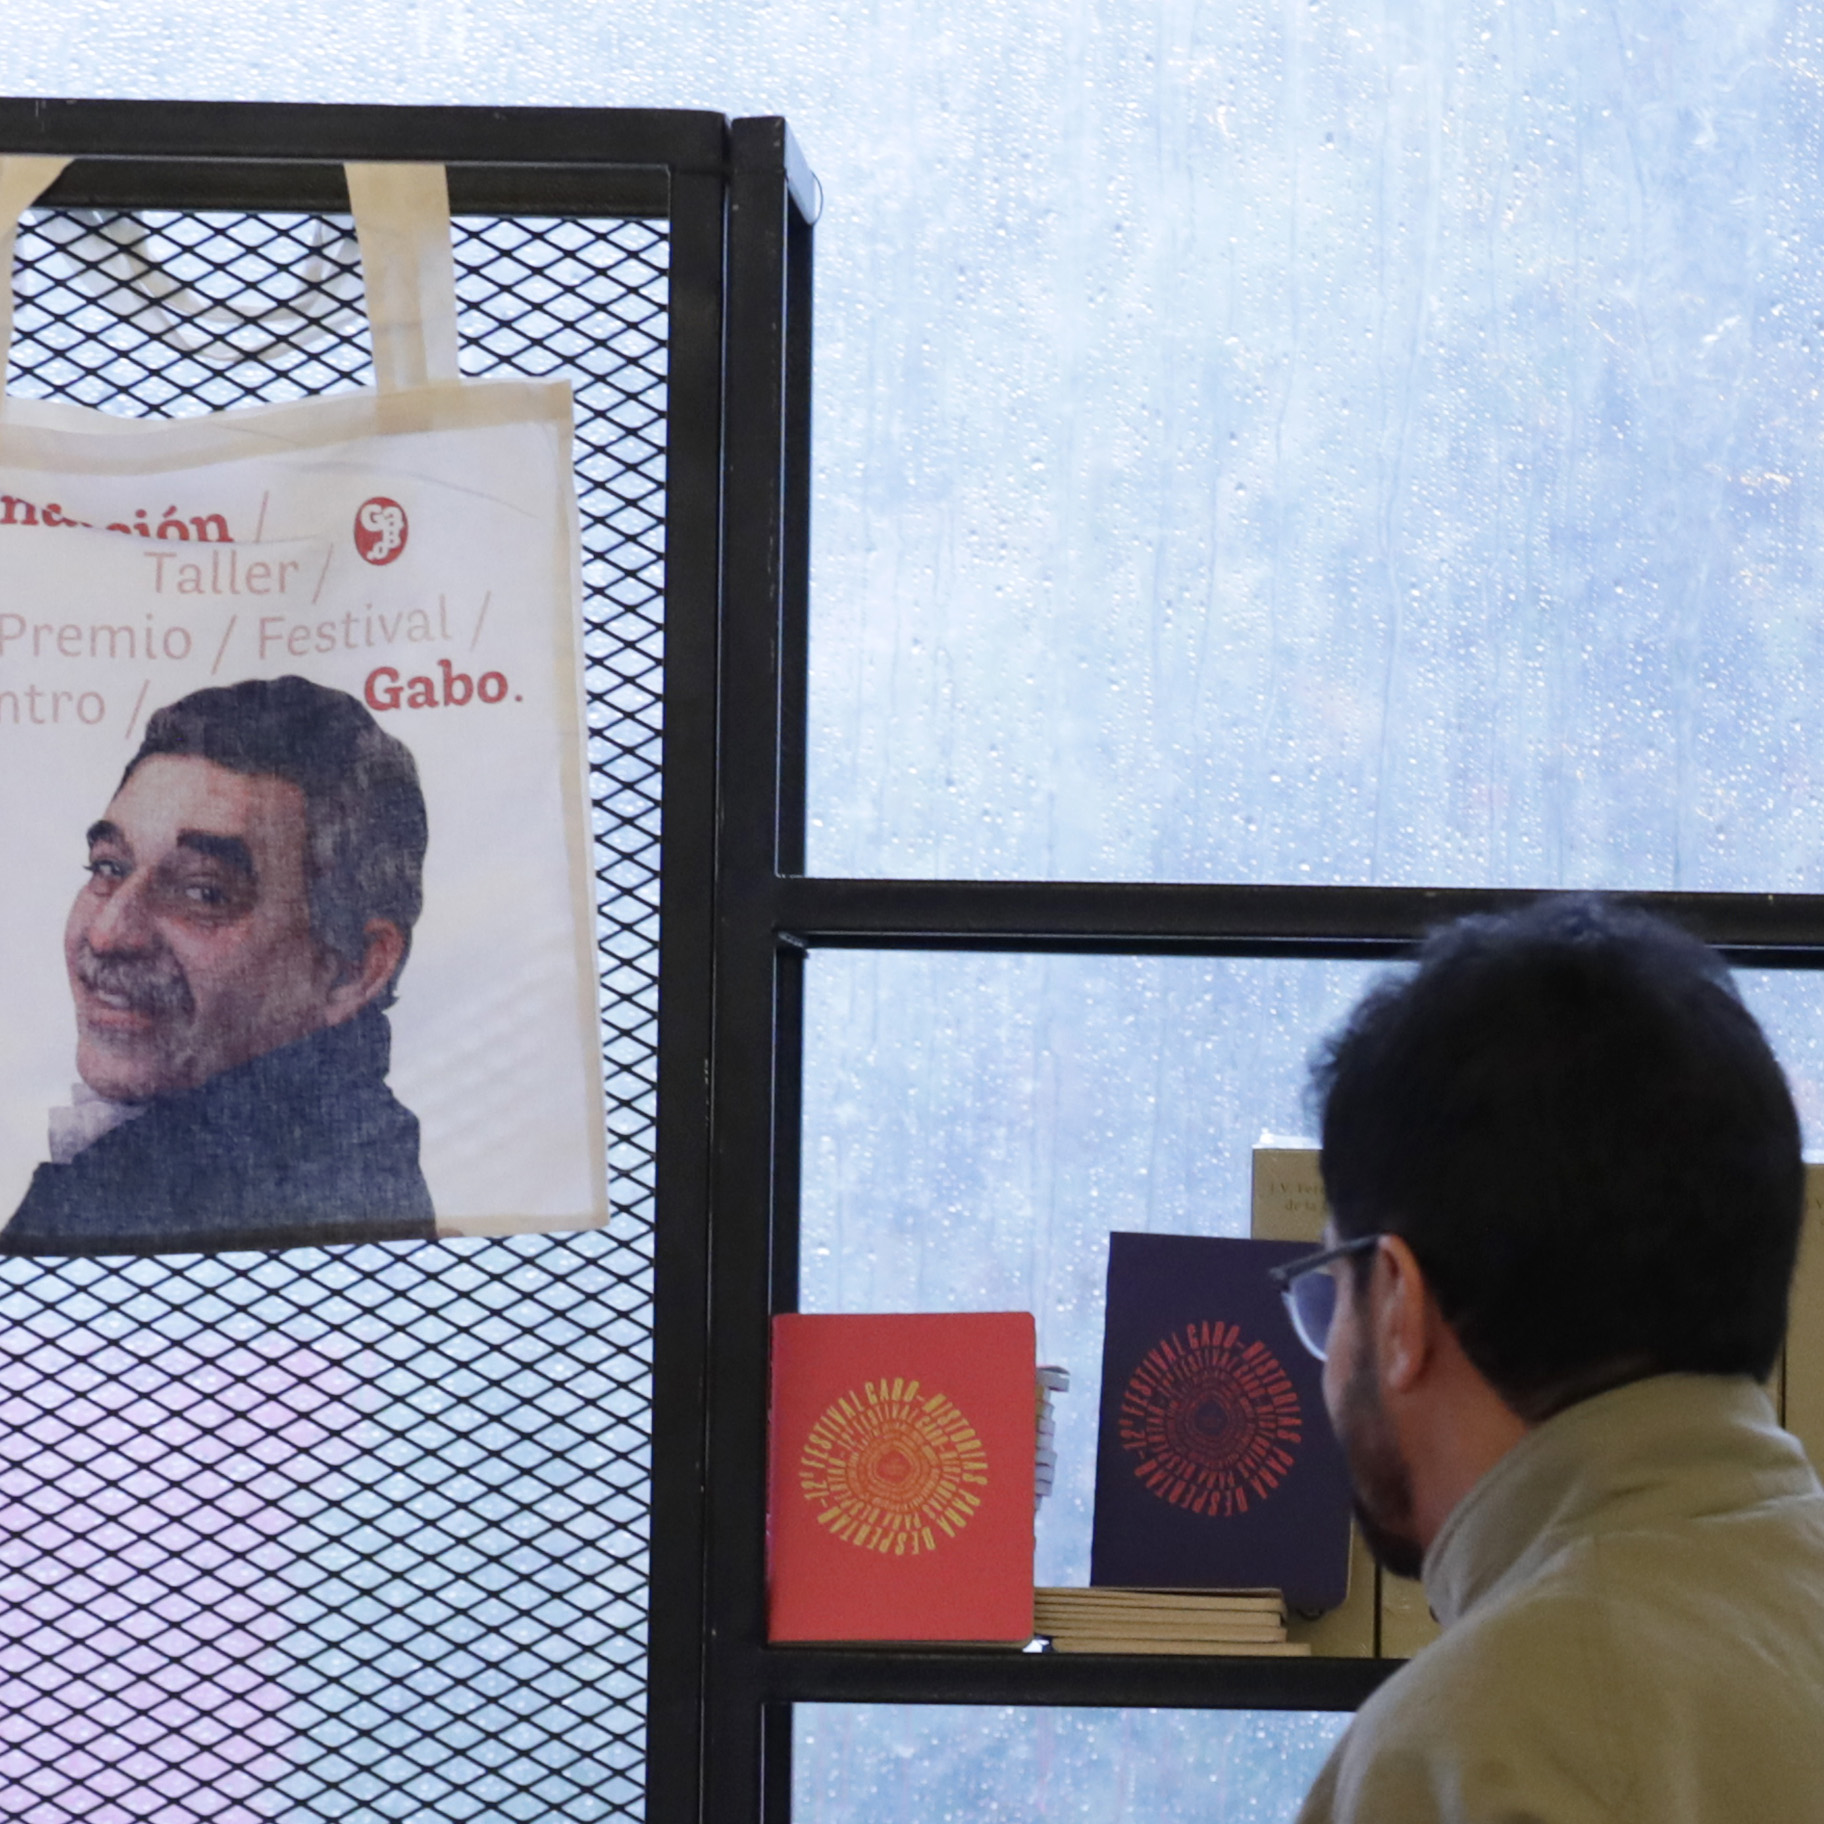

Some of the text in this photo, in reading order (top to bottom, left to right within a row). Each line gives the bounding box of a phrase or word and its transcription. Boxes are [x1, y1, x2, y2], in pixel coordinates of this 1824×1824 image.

[143, 550, 300, 597] Taller
[258, 593, 453, 662] Festival
[364, 659, 524, 714] Gabo.
[865, 1377, 920, 1405] GABO
